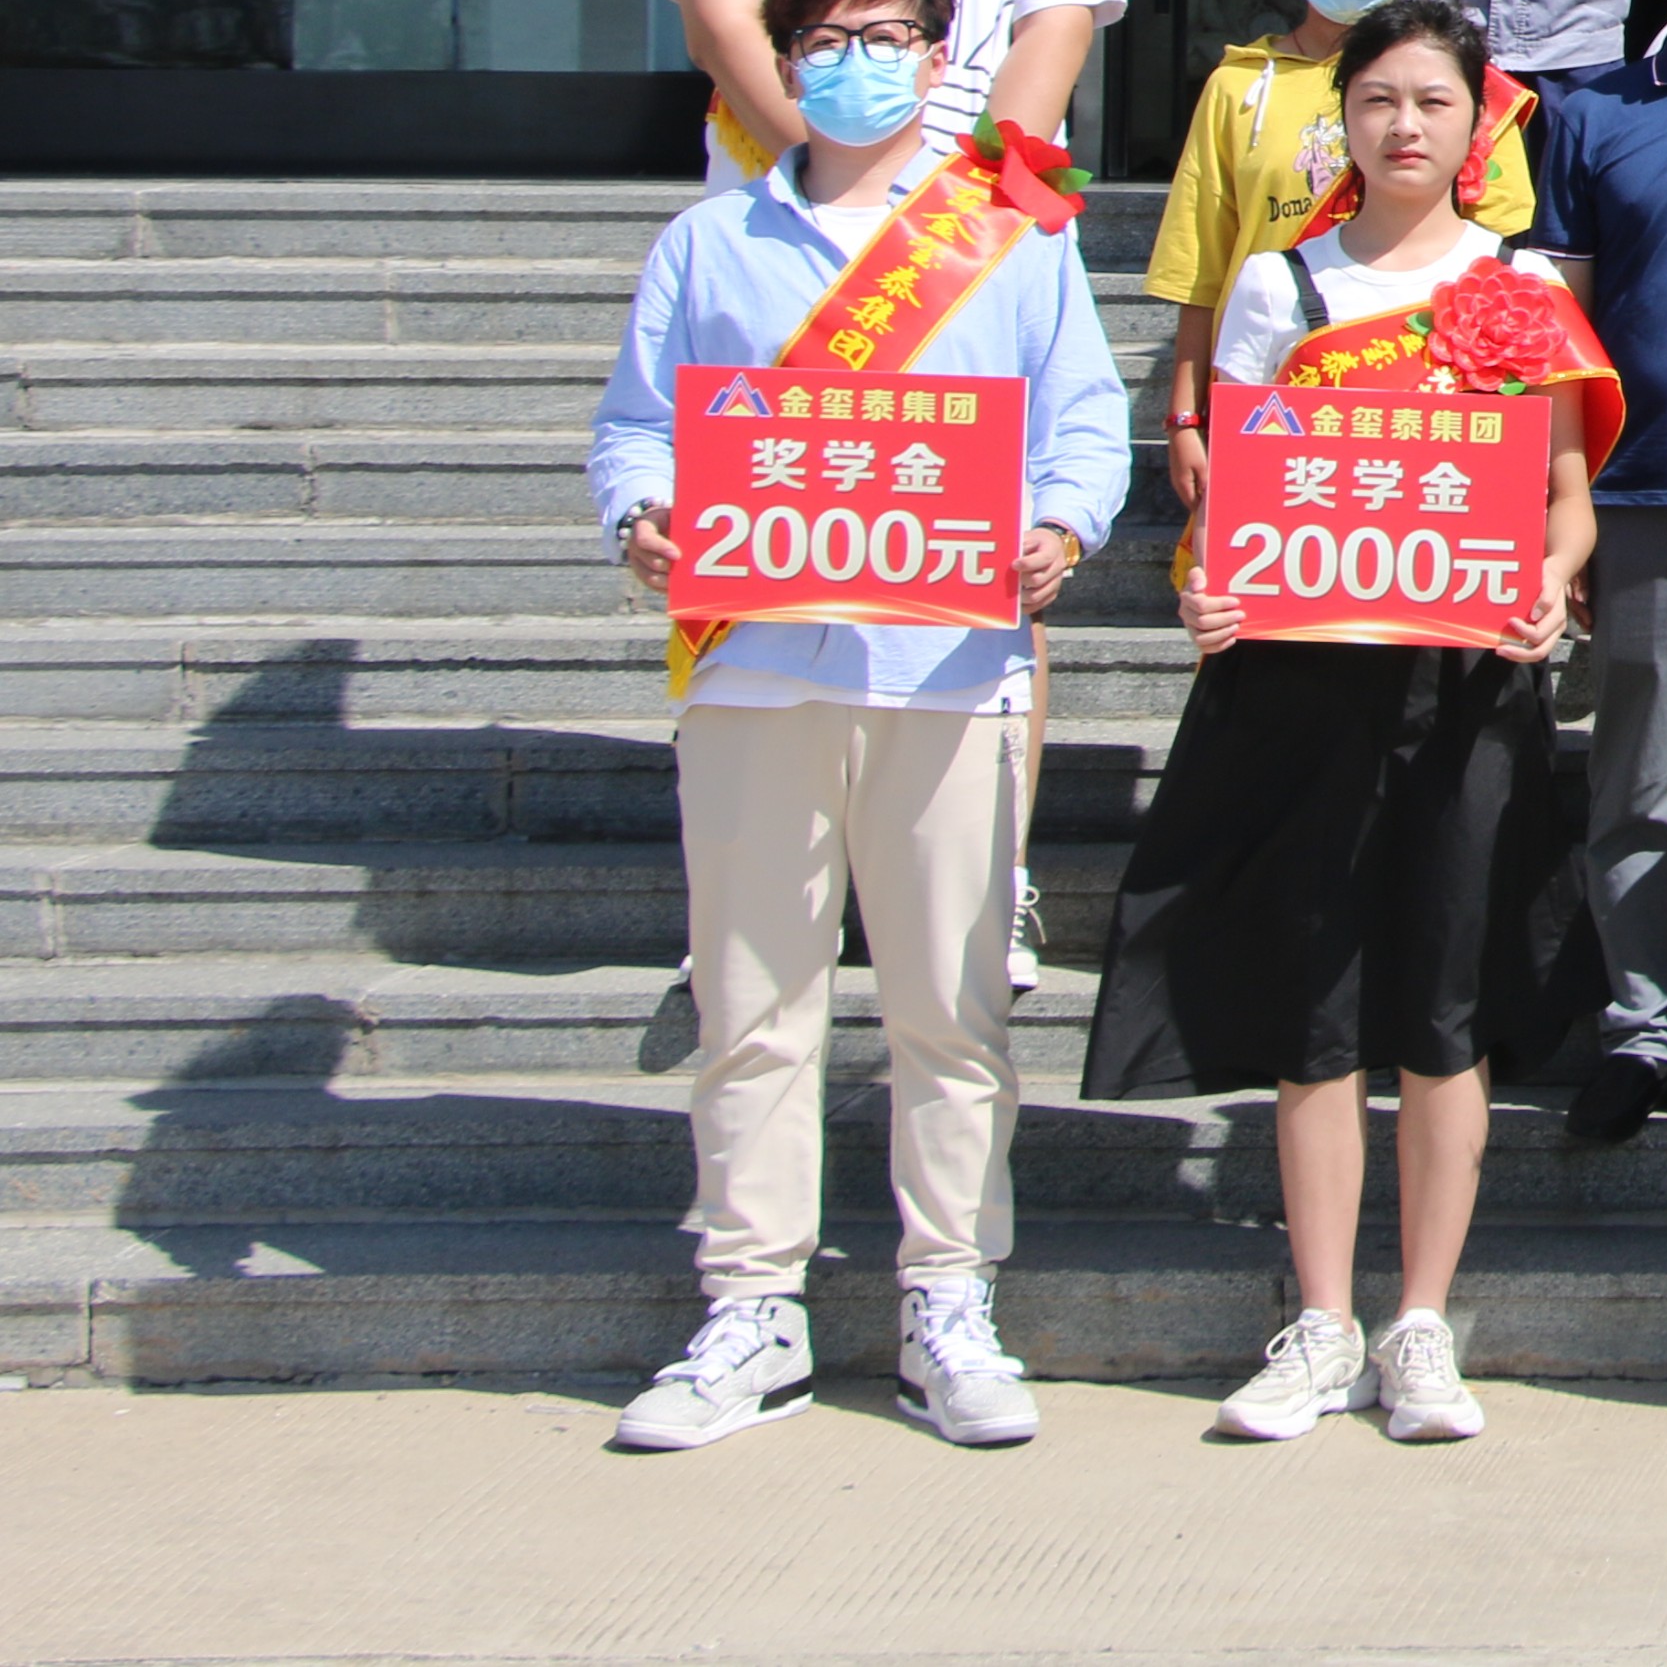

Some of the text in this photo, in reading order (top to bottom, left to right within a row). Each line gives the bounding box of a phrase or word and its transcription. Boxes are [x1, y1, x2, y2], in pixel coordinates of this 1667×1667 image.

[779, 385, 978, 425] 金玺泰集团
[1310, 404, 1502, 444] 金玺泰集团
[750, 438, 946, 495] 奖学金
[1283, 456, 1472, 513] 奖学金
[693, 503, 997, 585] 2000元
[1227, 522, 1519, 605] 2000元
